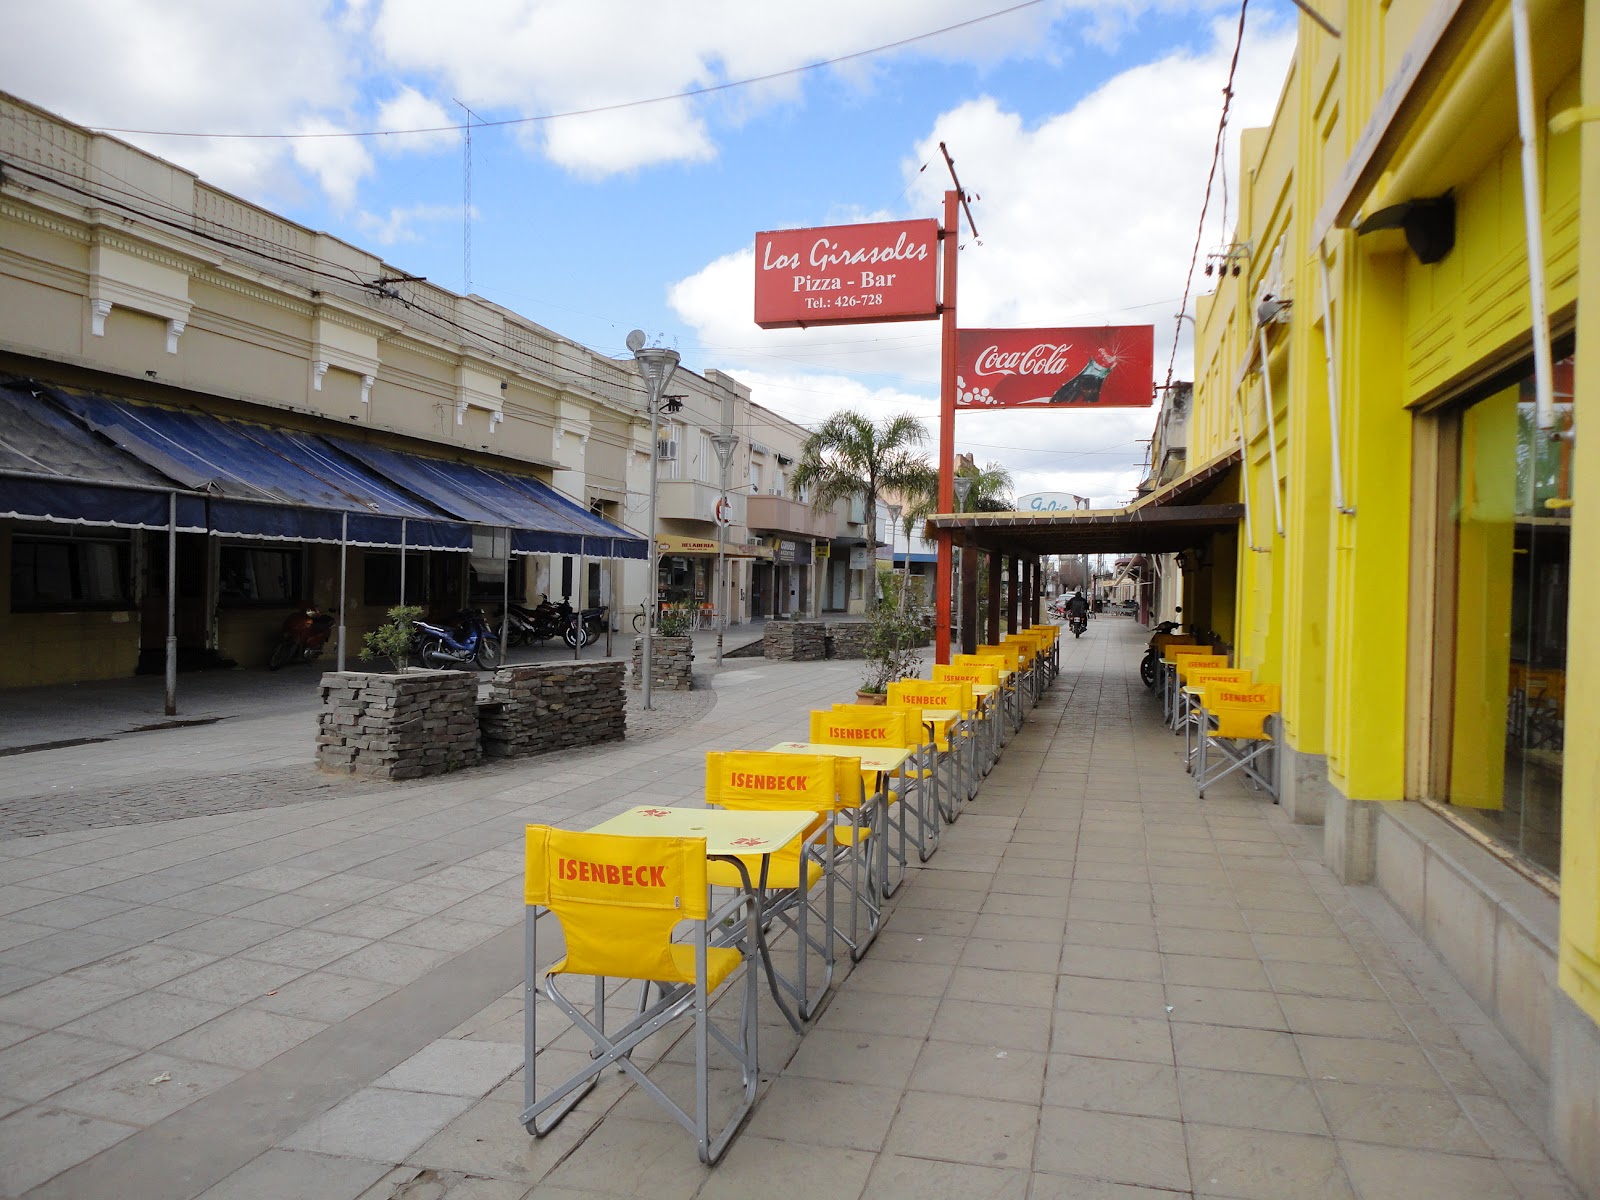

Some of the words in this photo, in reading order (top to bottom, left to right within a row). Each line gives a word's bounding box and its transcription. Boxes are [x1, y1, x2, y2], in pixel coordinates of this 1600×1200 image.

[763, 241, 801, 271] Los
[809, 231, 929, 272] Girasoles
[792, 275, 842, 293] Pizza
[860, 271, 897, 289] Bar
[805, 297, 831, 309] Tel.:
[834, 293, 883, 308] 426-728
[975, 343, 1073, 376] Coca-Cola
[902, 694, 948, 706] ISENBECK
[1220, 692, 1266, 703] ISENBECK
[829, 726, 887, 740] ISENBECK
[731, 771, 808, 791] ISENBECK
[558, 858, 667, 888] ISENBECK
